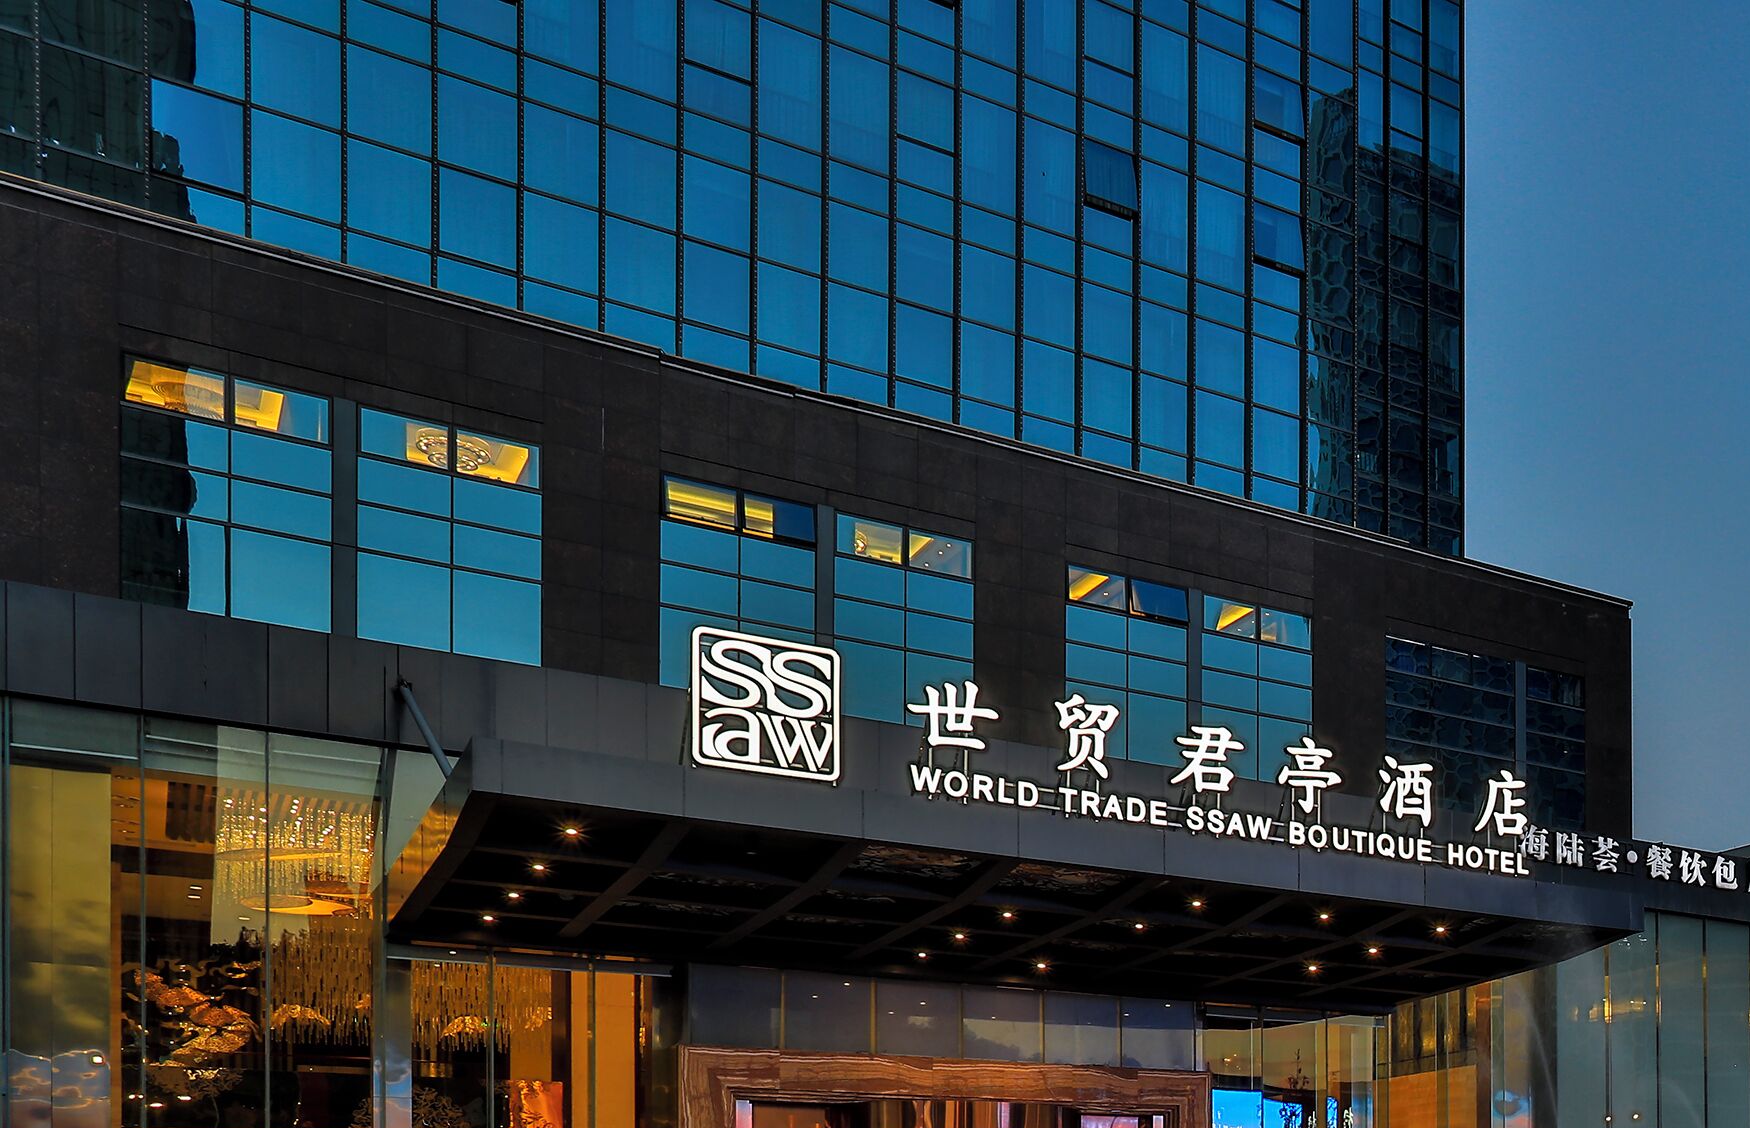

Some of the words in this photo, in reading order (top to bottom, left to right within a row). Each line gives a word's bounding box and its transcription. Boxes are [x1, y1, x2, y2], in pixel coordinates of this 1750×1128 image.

[907, 680, 1529, 836] 世贸君亭酒店
[910, 764, 1039, 808] WORLD
[1058, 787, 1168, 826] TRADE
[1186, 806, 1272, 841] SSAW
[1289, 821, 1433, 863] BOUTIQUE
[1448, 843, 1530, 876] HOTEL
